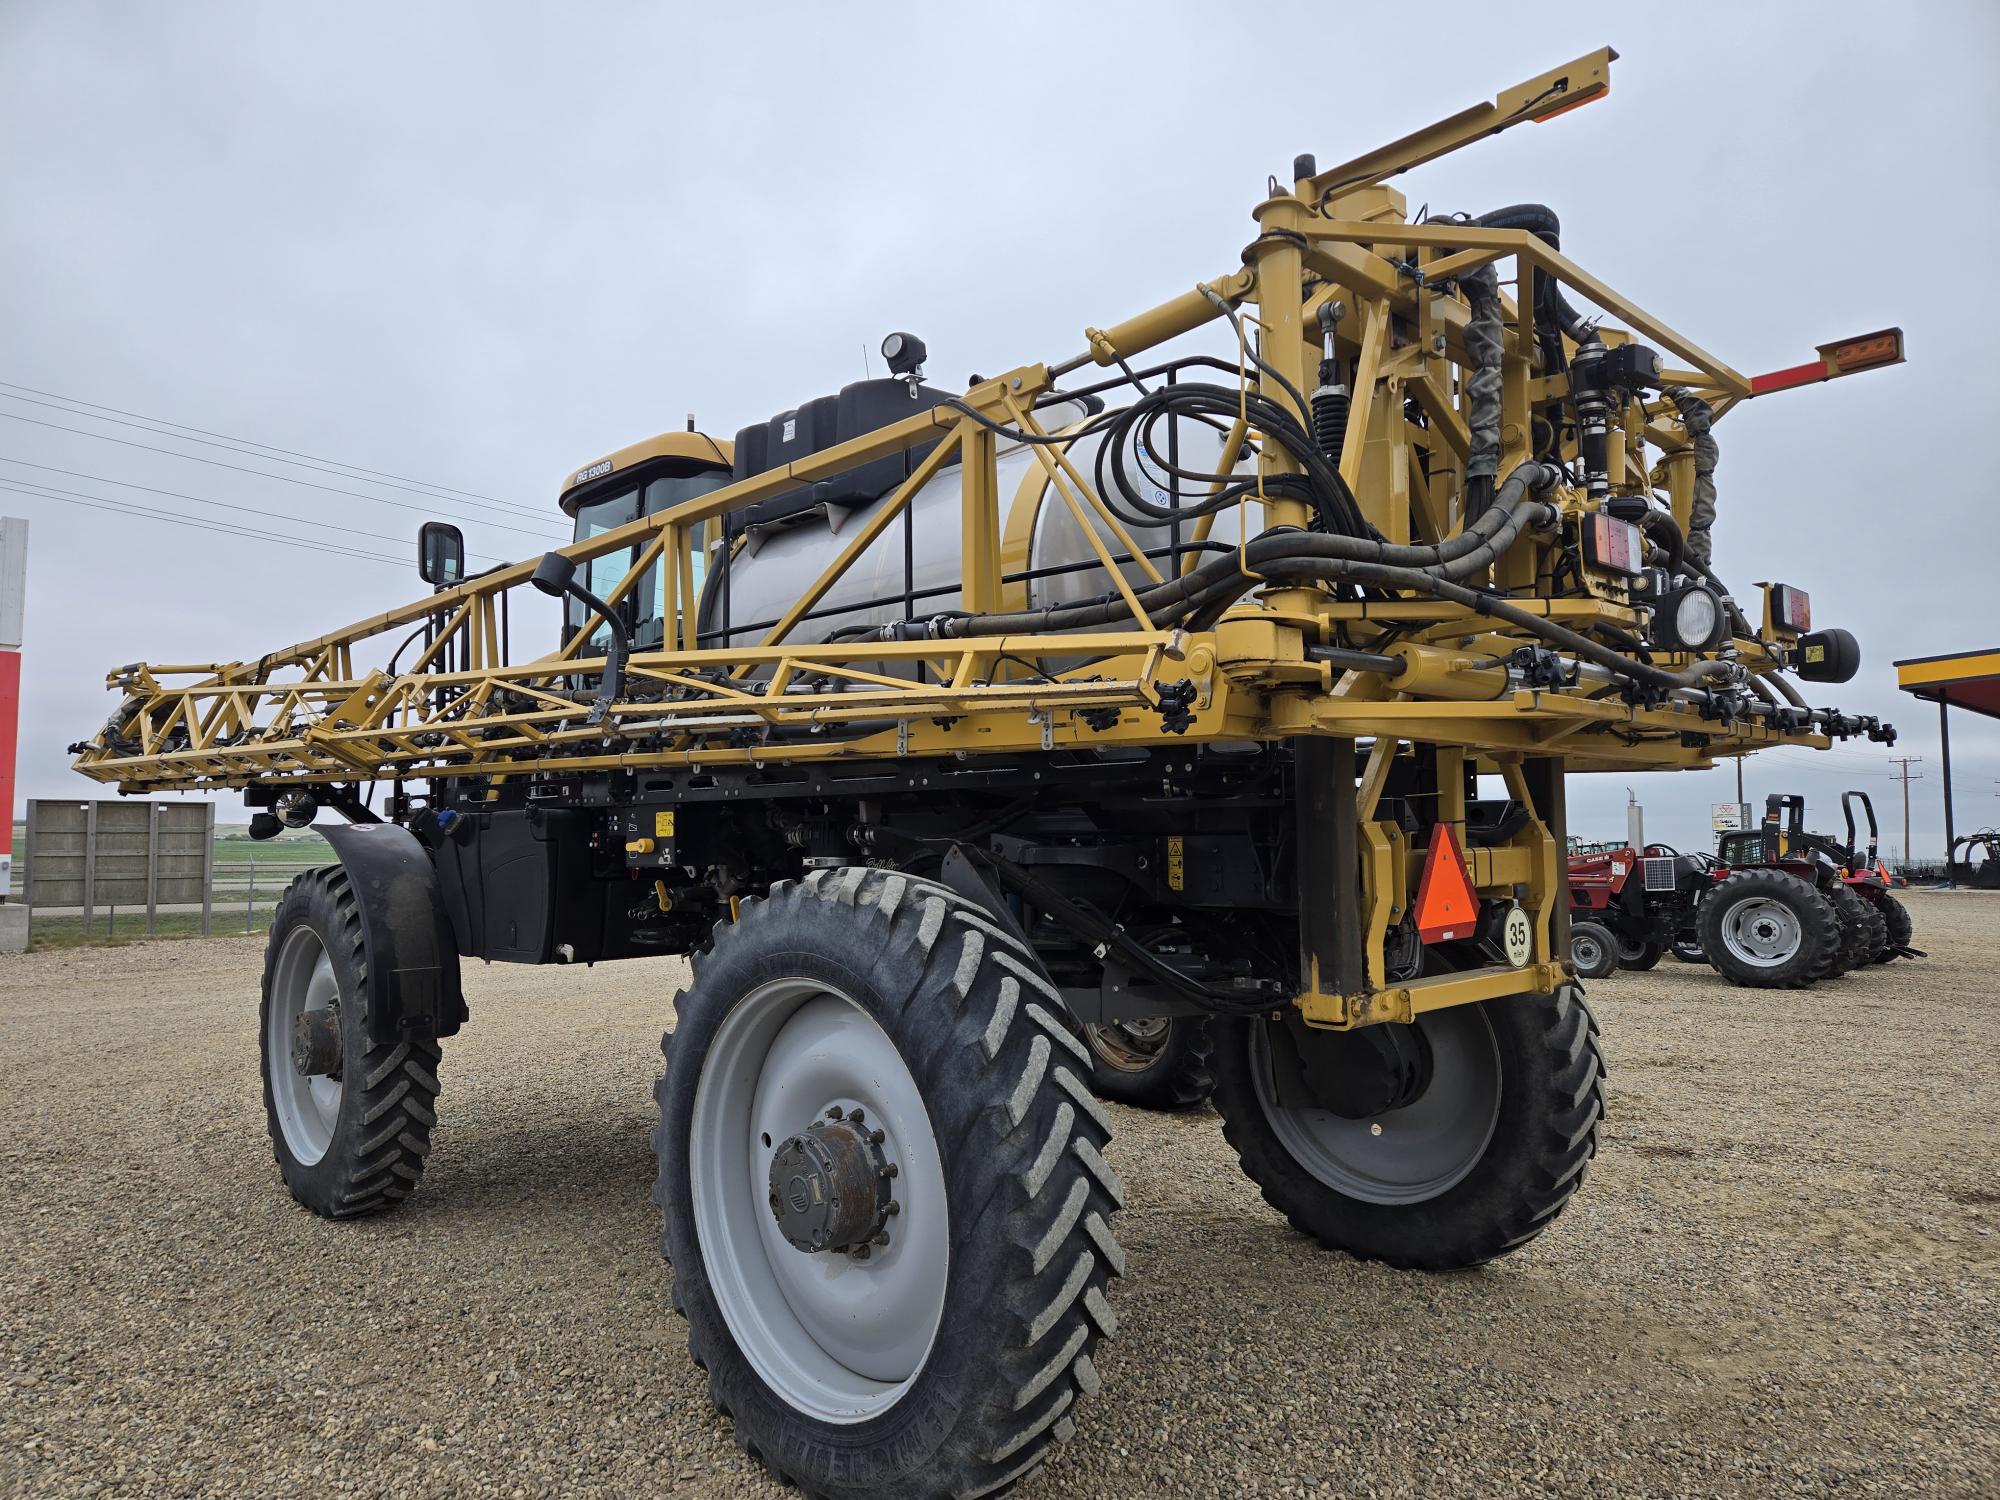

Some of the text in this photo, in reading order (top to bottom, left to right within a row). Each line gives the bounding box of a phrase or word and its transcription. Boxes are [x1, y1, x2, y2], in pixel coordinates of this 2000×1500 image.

[576, 461, 610, 483] RG 1300B
[1509, 921, 1526, 947] 35
